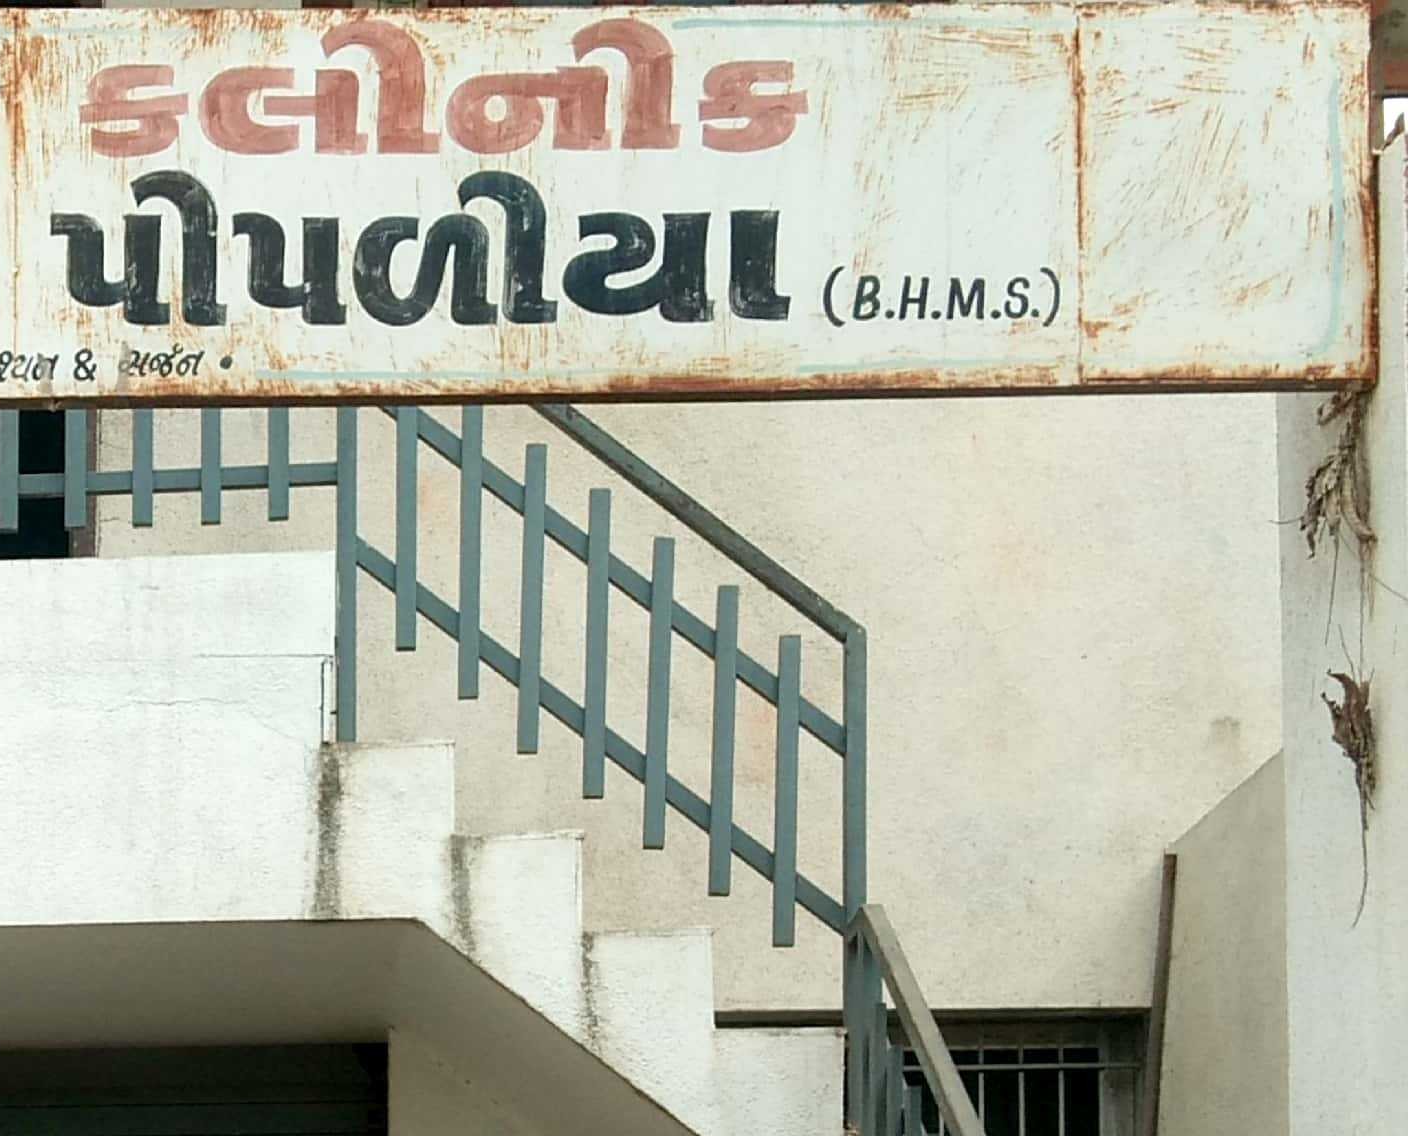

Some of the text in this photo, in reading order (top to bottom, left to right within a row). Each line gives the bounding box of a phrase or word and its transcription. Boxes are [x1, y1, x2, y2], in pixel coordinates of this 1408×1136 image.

[78, 18, 809, 158] કલીનીક
[49, 169, 791, 327] પીપળીયા
[822, 266, 1062, 328] (B.H.M.S.)
[73, 347, 98, 382] &
